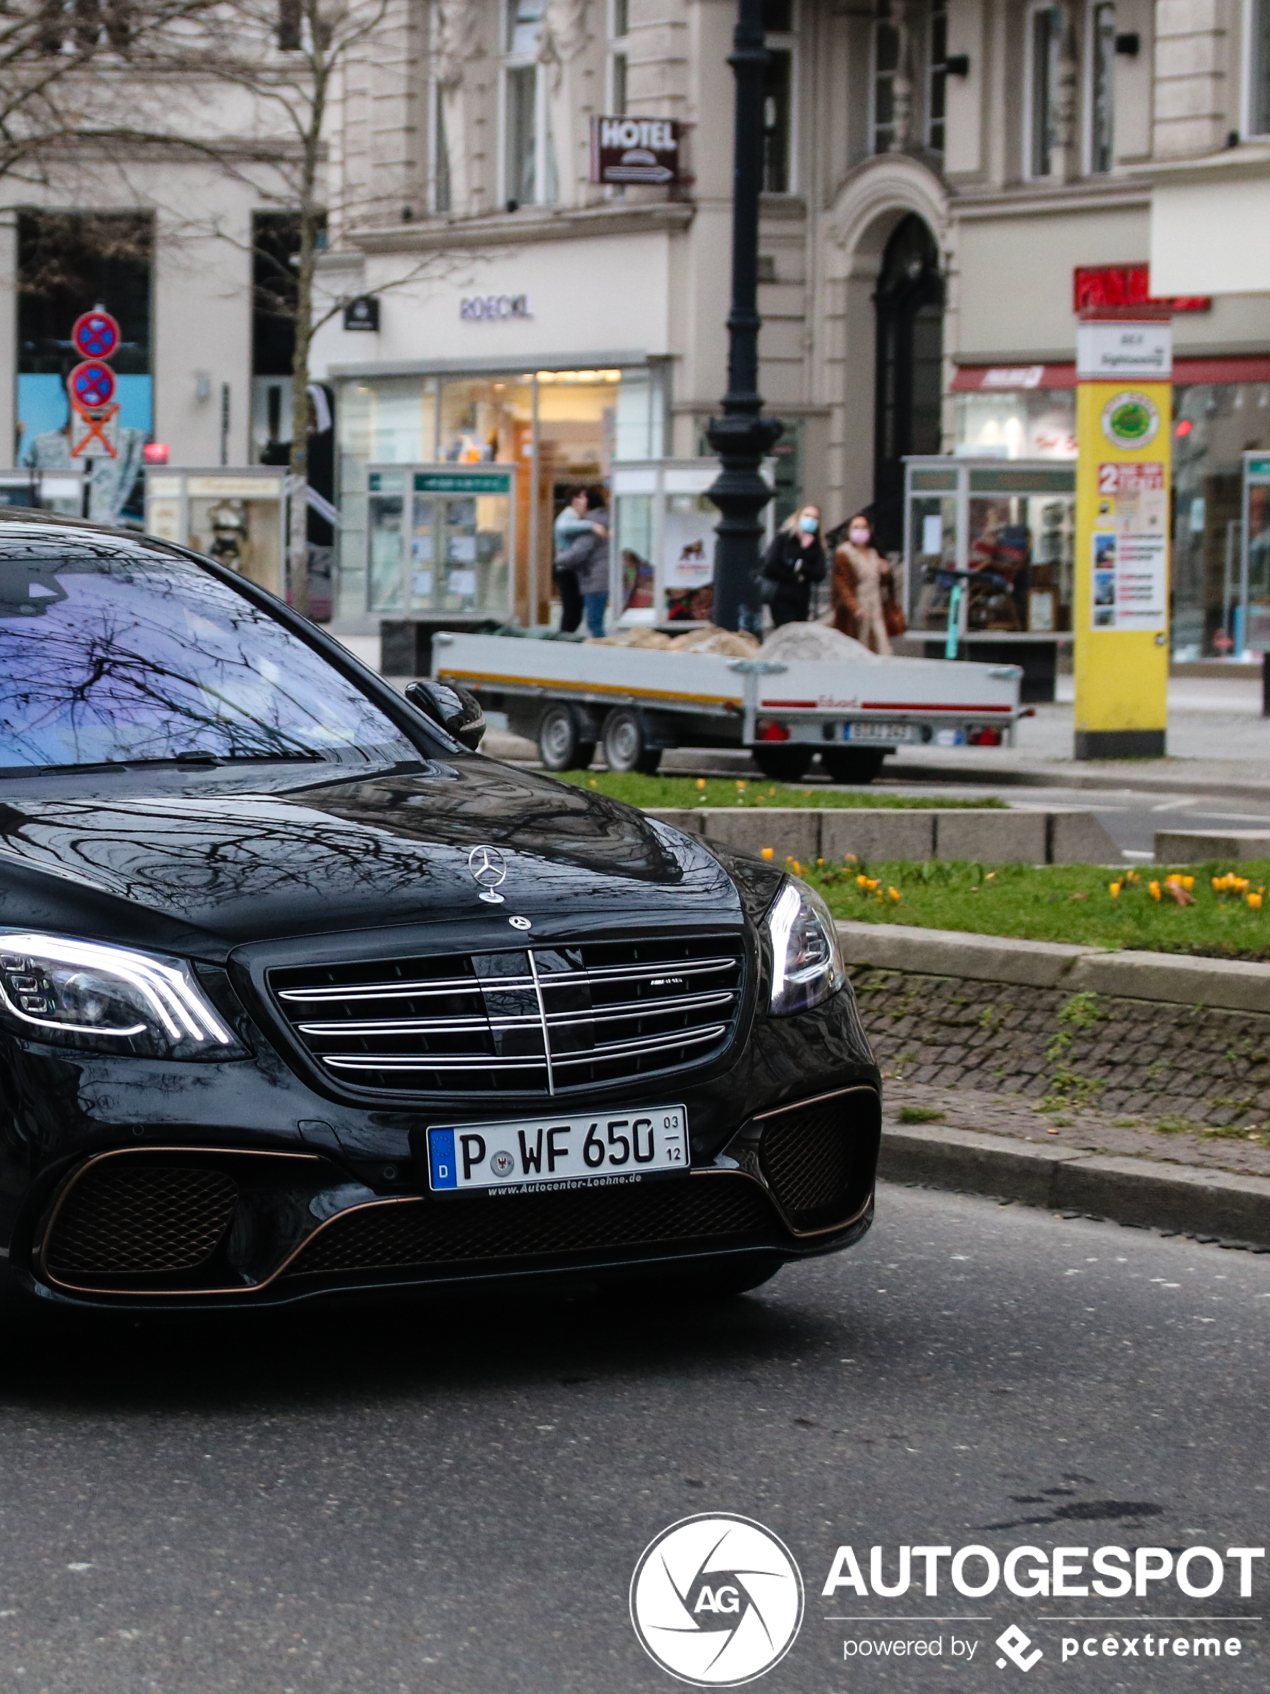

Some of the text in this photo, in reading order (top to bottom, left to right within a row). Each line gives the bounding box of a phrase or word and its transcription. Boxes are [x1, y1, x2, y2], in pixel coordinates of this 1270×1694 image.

[601, 120, 677, 150] HOTEL
[461, 293, 534, 321] ROECKL
[1100, 464, 1118, 493] 2
[663, 1115, 679, 1129] 03
[459, 1118, 655, 1180] P WF 650
[666, 1147, 681, 1162] 12
[438, 1164, 448, 1179] D
[488, 1173, 642, 1197] www.Autocenter-Loehne.de
